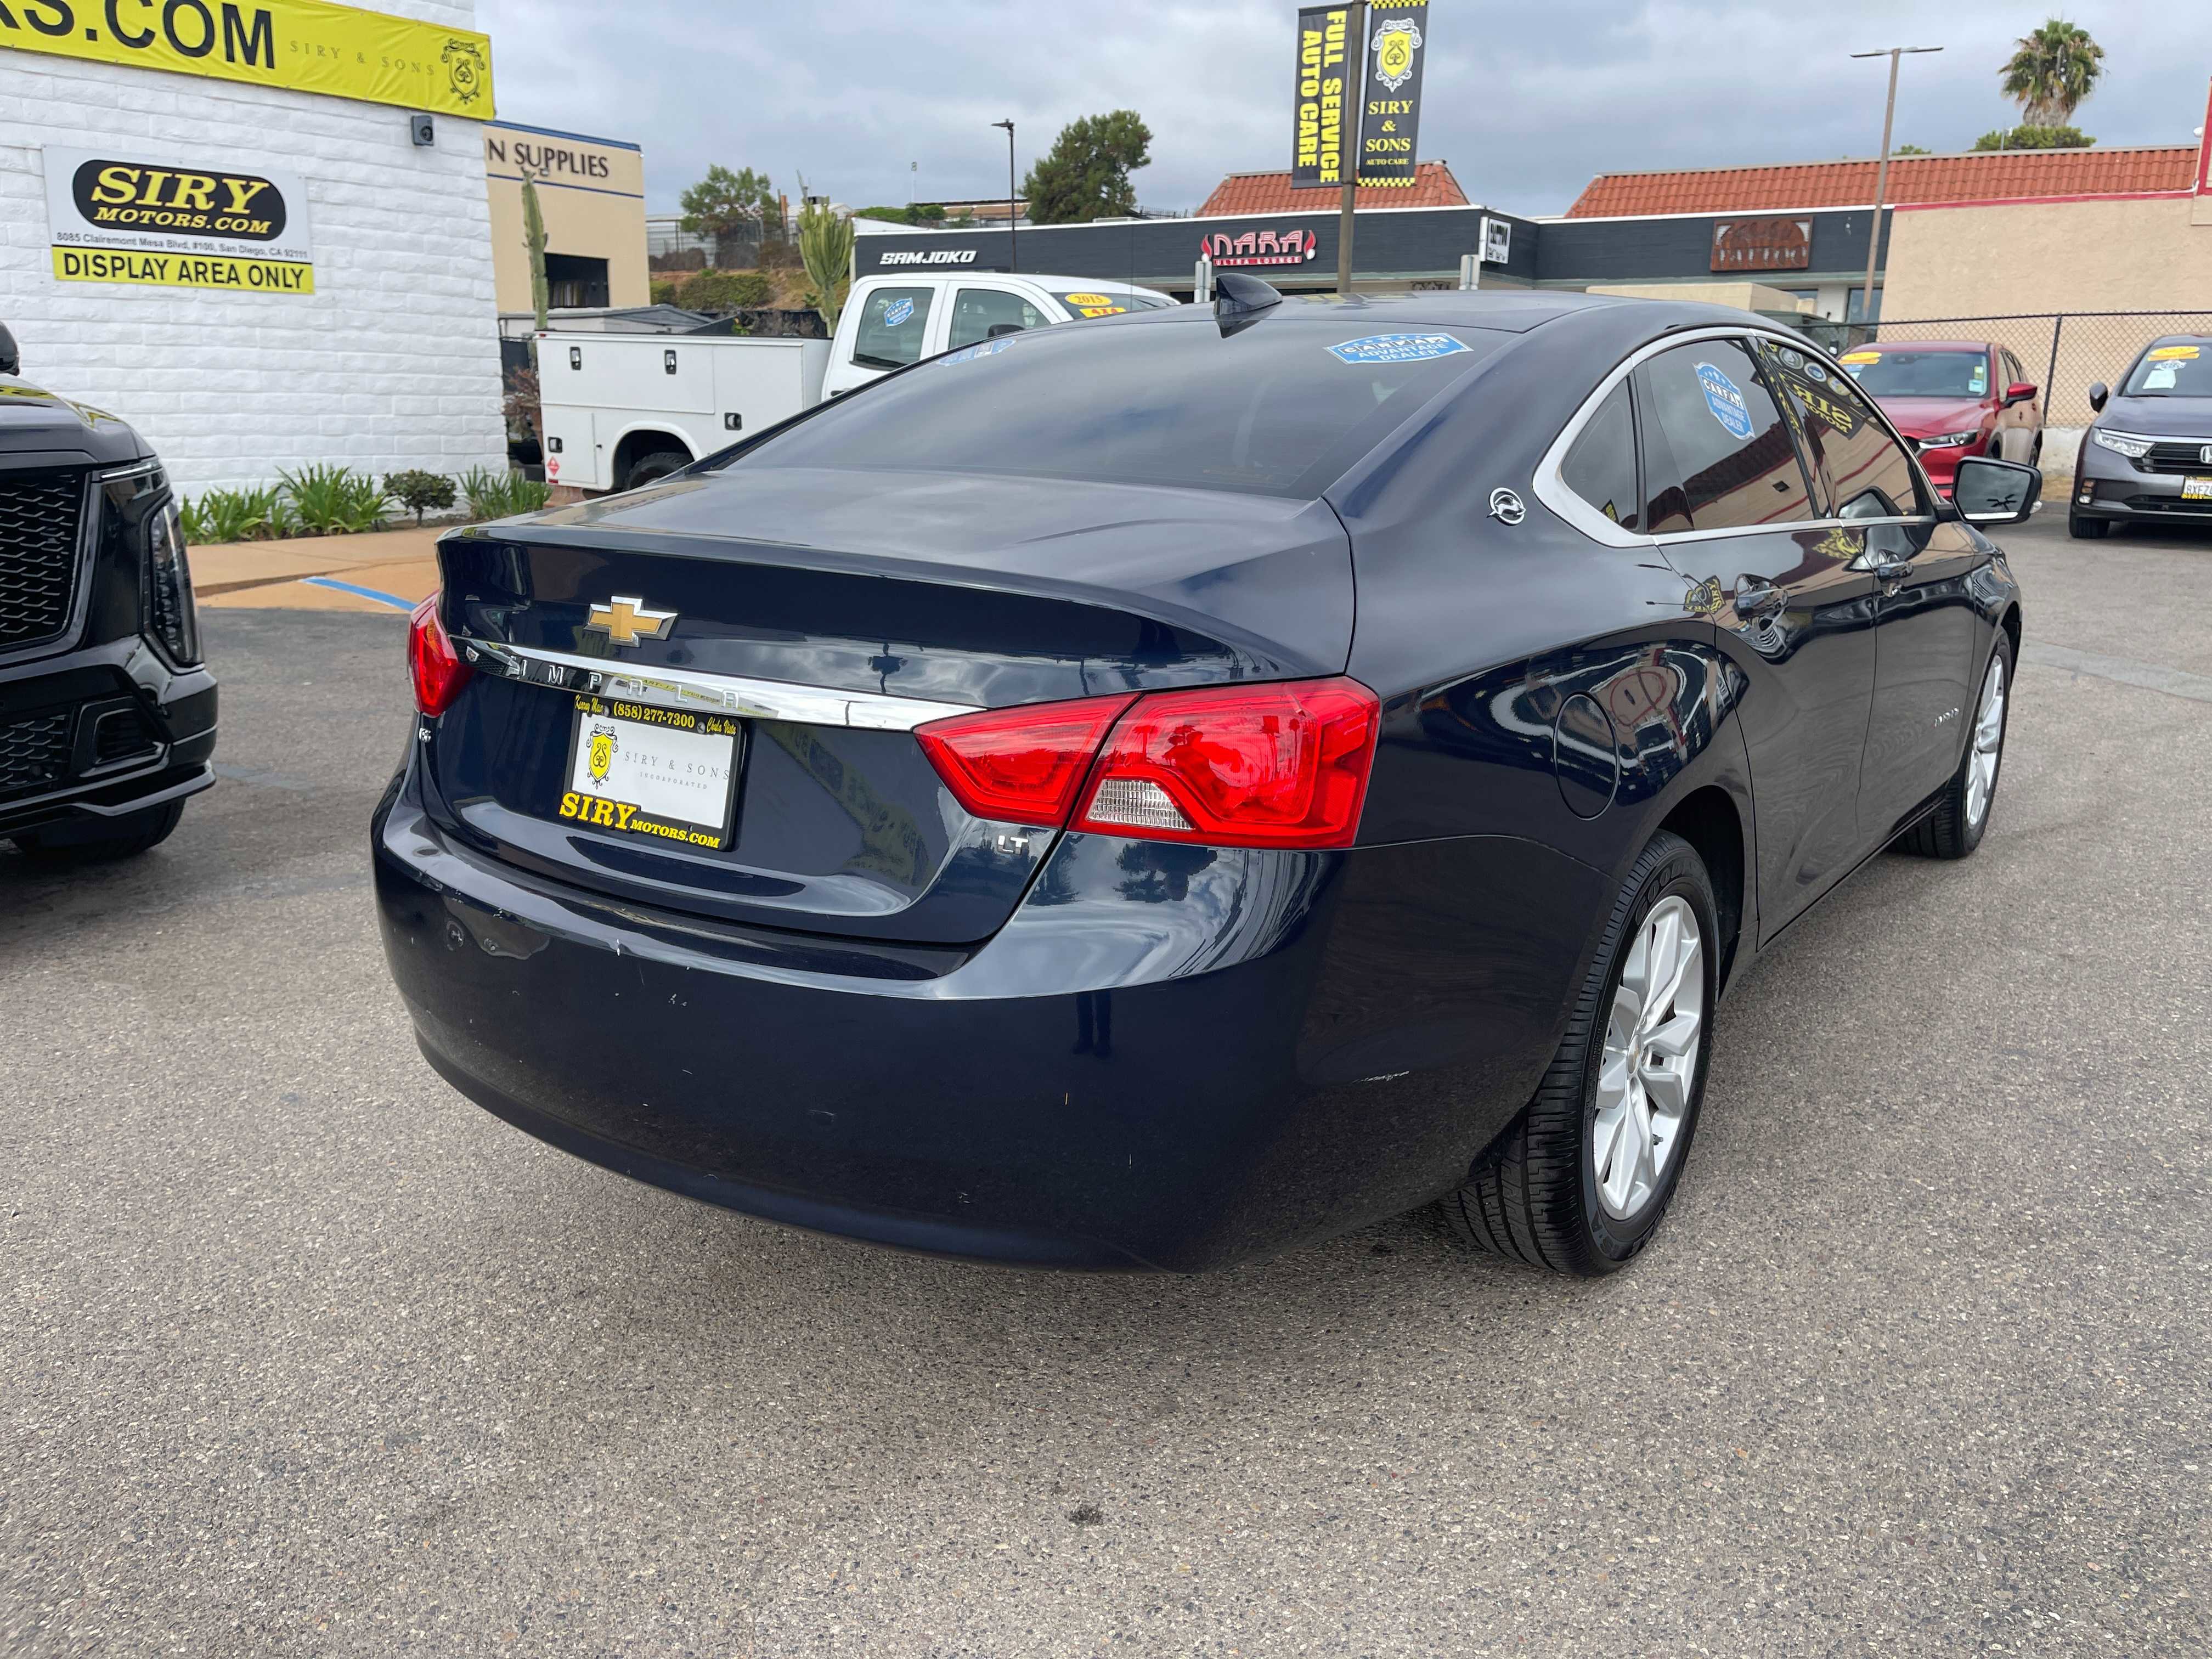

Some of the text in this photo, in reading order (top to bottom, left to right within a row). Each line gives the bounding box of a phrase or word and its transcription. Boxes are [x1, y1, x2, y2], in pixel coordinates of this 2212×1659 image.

[0, 0, 275, 69] S.COM
[290, 40, 435, 76] SIRY & SONS
[1299, 30, 1322, 167] AUTO CARE
[1320, 10, 1347, 183] FULL SERVICE
[1368, 100, 1414, 115] SIRY
[1381, 120, 1397, 132] &
[1365, 138, 1411, 153] SONS
[514, 142, 609, 178] SUPPLIES
[91, 166, 269, 215] SIRY
[93, 206, 272, 234] MOTORS.COM
[83, 234, 137, 246] Clairemont
[139, 237, 163, 247] Mesa
[219, 243, 238, 253] San
[269, 247, 284, 256] CA
[1214, 229, 1304, 256] NARA
[64, 253, 304, 289] DISPLAY AREA ONLY
[879, 250, 977, 265] SAMJOKO
[1216, 256, 1300, 266] ULTRA LOUNGE
[1344, 336, 1447, 354] CARFAX
[1358, 343, 1449, 358] ADVANTAGE
[1378, 349, 1440, 361] DEALER
[1702, 378, 1744, 410] CARFAX
[522, 659, 739, 709] IMPALA
[613, 701, 642, 720] (858)
[643, 708, 695, 729] 277-7300
[624, 751, 730, 780] SIRY & SONS
[639, 771, 708, 790] INCORPORATED
[559, 792, 721, 849] SIRY MOTORS.COM
[997, 834, 1029, 855] LT
